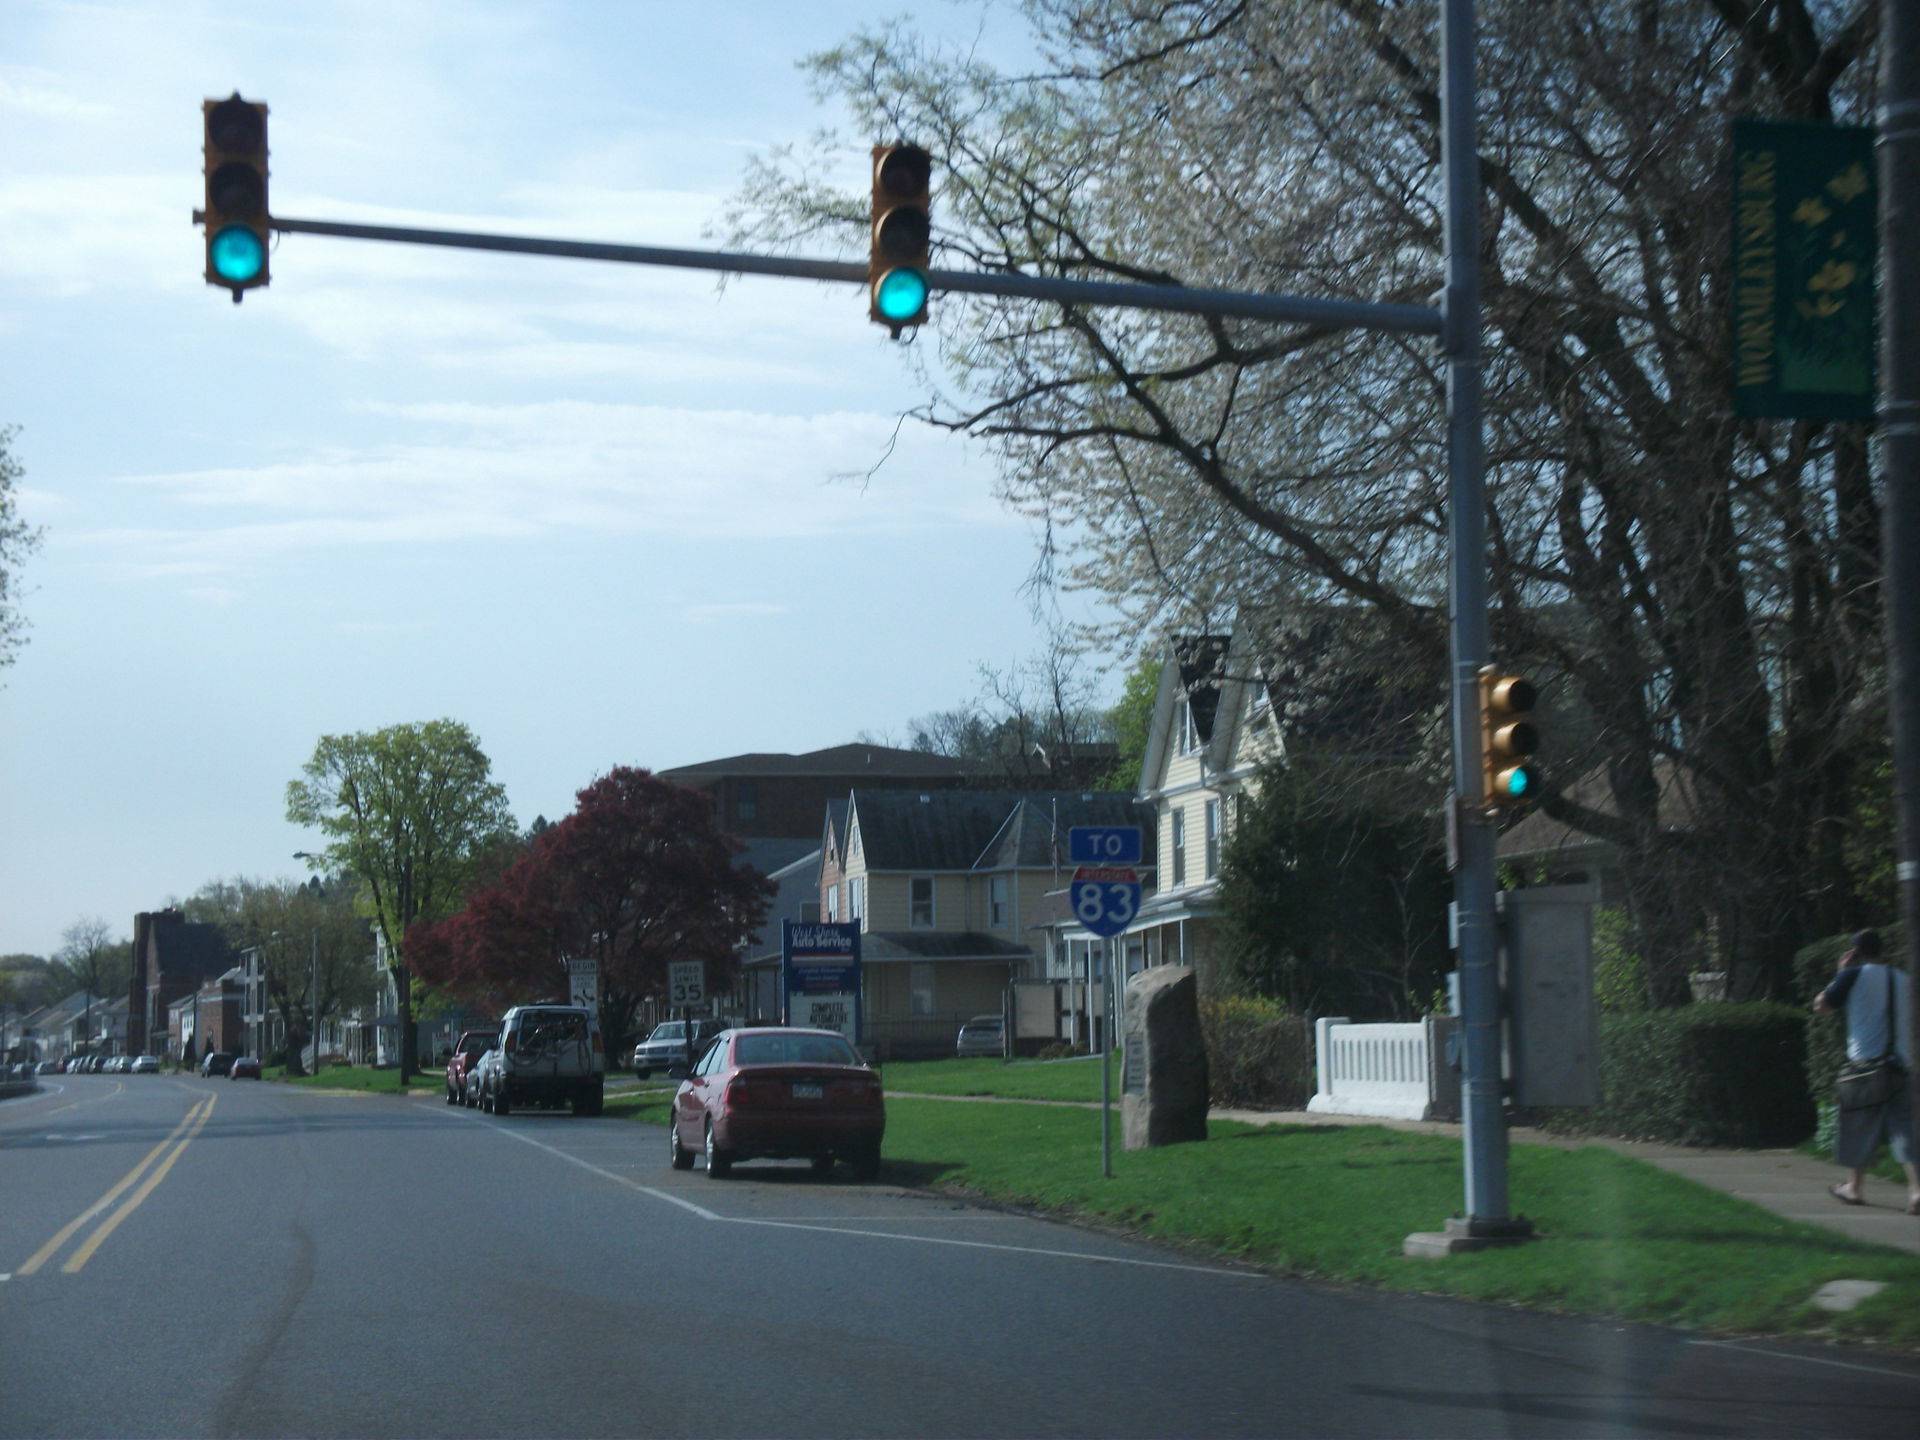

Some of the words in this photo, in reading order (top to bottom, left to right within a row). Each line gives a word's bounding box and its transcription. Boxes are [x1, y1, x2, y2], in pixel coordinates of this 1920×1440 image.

[1737, 150, 1776, 387] WORMLEYSBURG
[1088, 834, 1122, 856] TO
[1078, 883, 1133, 923] 83
[792, 936, 814, 948] Auto
[815, 936, 851, 947] Service
[674, 966, 699, 975] SPEED
[674, 976, 698, 984] LIMIT
[674, 985, 702, 1002] 35
